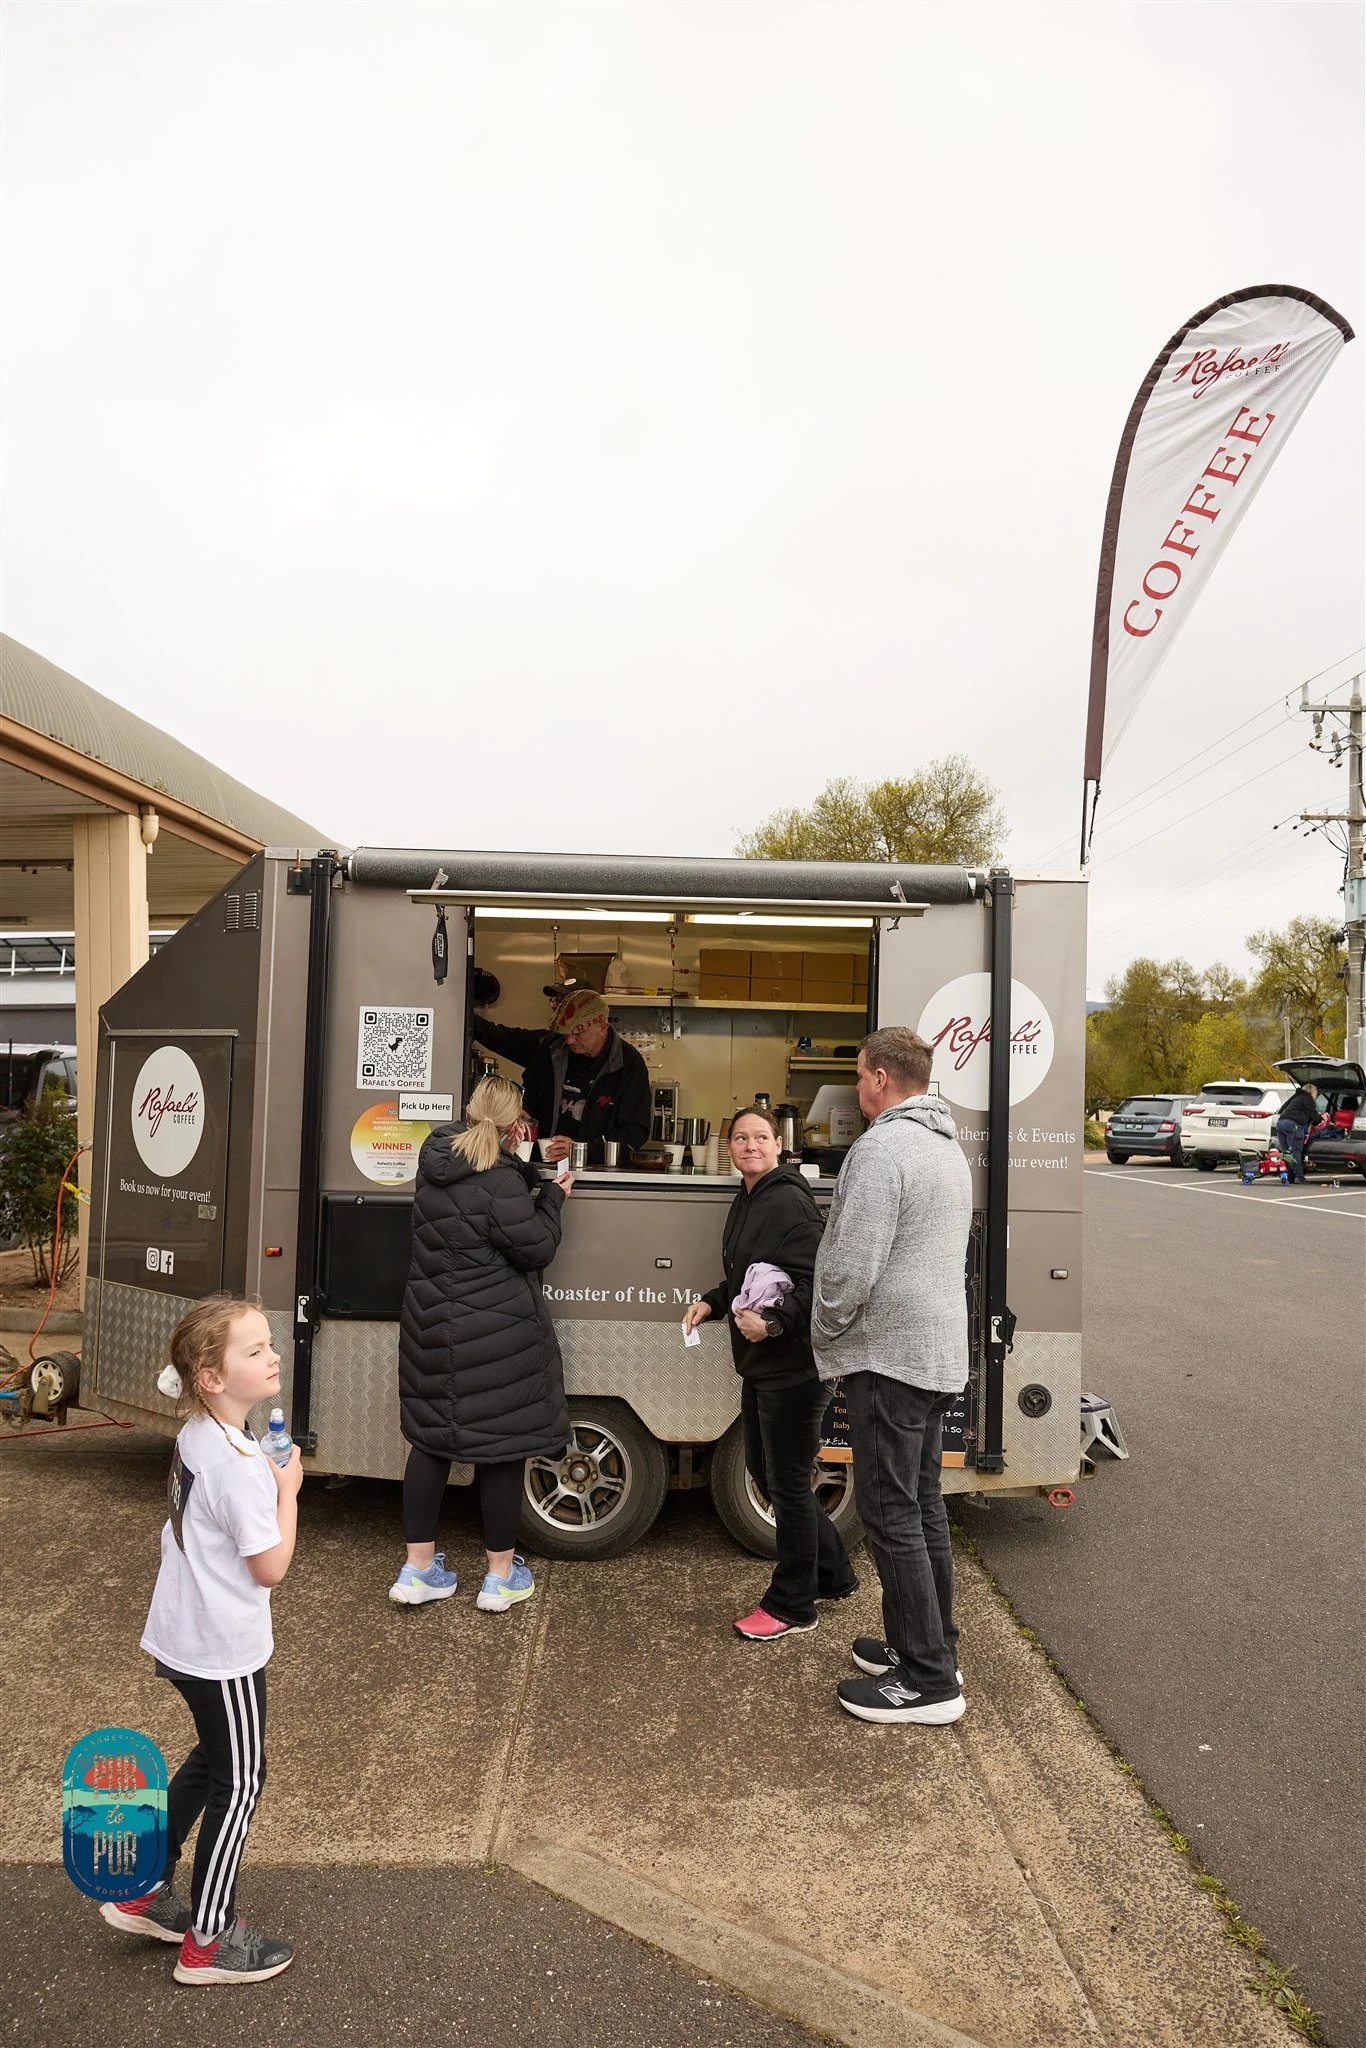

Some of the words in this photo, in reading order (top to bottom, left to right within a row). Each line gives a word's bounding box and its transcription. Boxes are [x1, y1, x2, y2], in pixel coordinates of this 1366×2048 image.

[1172, 341, 1291, 399] Rafael's
[1123, 406, 1276, 637] COFFEE
[931, 1016, 1041, 1071] Rafl's
[1012, 1044, 1038, 1054] FFEE
[362, 1079, 395, 1087] RAFAEL'S
[397, 1080, 425, 1088] COFFEE
[138, 1084, 198, 1138] Rafael's
[419, 1103, 430, 1111] Up
[432, 1103, 450, 1111] Here
[173, 1114, 195, 1125] COFFEE
[955, 1126, 1012, 1142] atheris
[1017, 1128, 1028, 1142] &
[1032, 1128, 1076, 1143] Events
[372, 1142, 412, 1151] WINNER
[978, 1153, 988, 1167] fo
[1008, 1158, 1027, 1168] our
[1030, 1156, 1068, 1169] event!
[120, 1178, 136, 1192] Book
[137, 1184, 145, 1194] us
[145, 1185, 160, 1196] now
[161, 1183, 171, 1197] for
[172, 1188, 188, 1202] your
[188, 1190, 211, 1203] event!
[542, 1284, 610, 1302] Roaster
[615, 1286, 635, 1302] of
[638, 1288, 667, 1304] the
[833, 1406, 847, 1415] Tea
